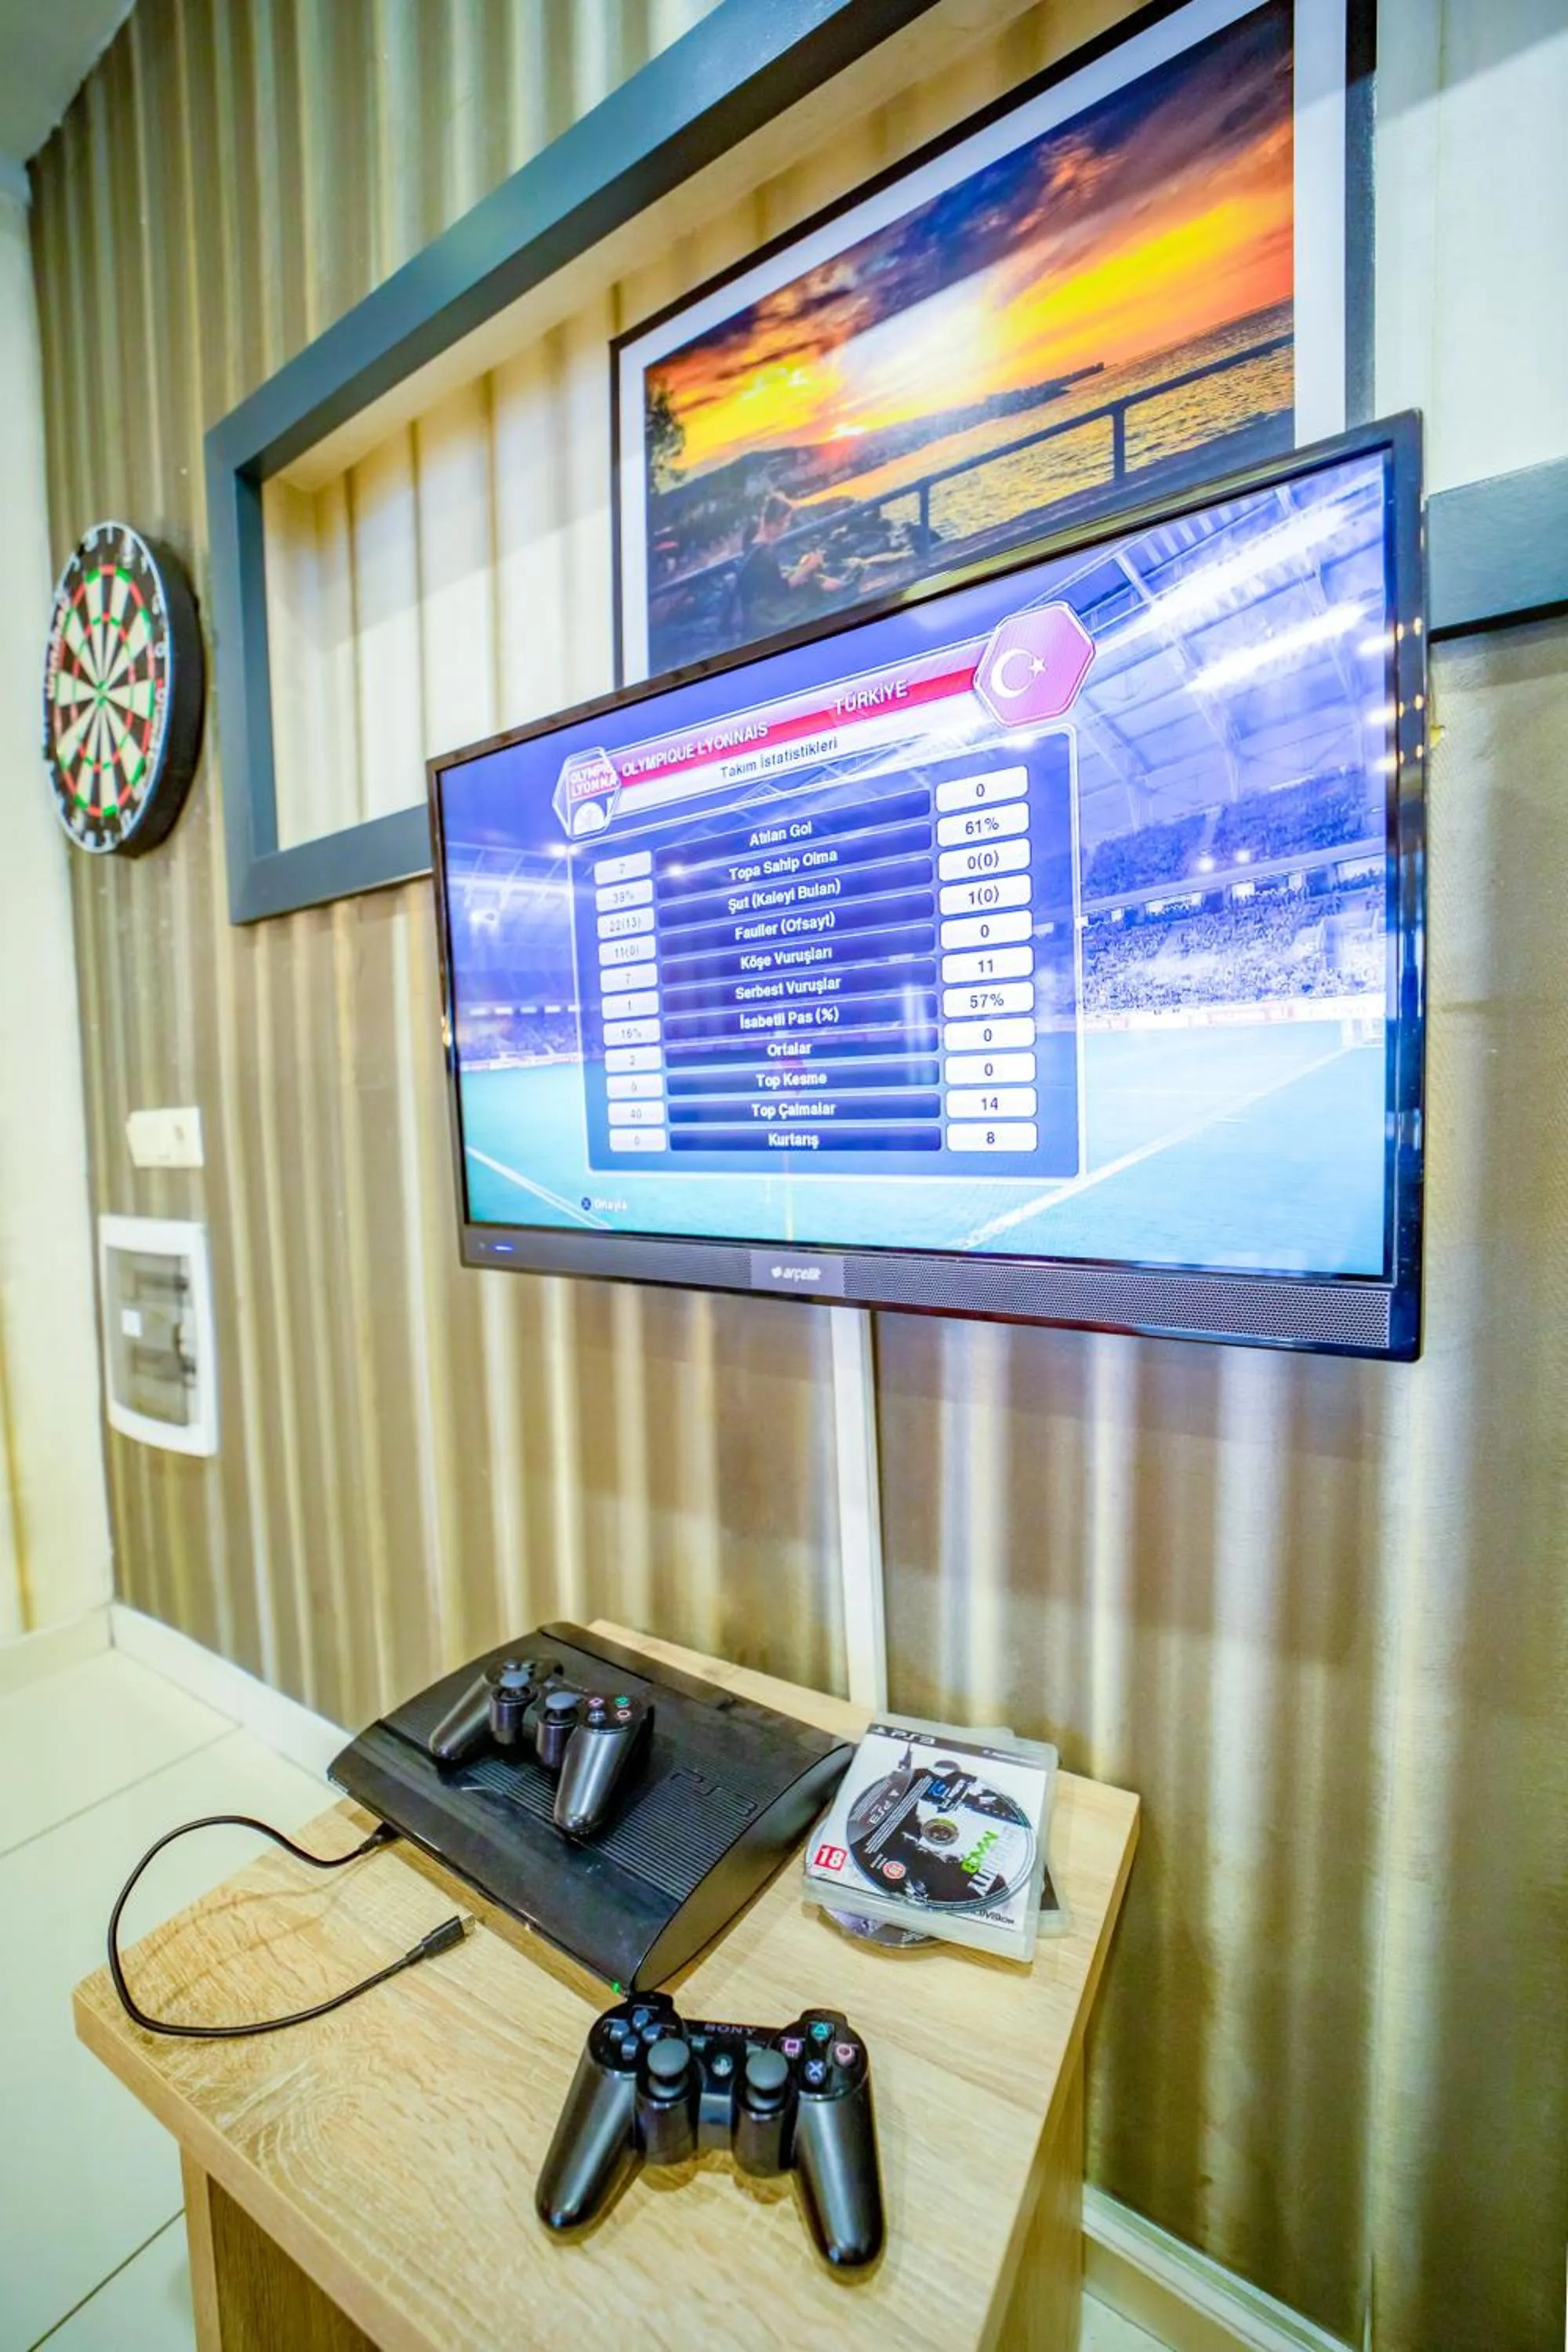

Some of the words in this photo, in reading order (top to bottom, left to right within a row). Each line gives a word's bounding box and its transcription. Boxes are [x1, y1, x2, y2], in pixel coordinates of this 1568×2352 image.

[834, 679, 909, 716] TÜRKİYE
[622, 743, 696, 777] OLYMPIQUE
[697, 721, 769, 756] LYONNAIS
[976, 783, 985, 797] 0
[789, 820, 812, 837] Gol
[965, 816, 1000, 835] 61%
[728, 866, 761, 881] Topa
[763, 857, 800, 874] Sahip
[802, 850, 838, 866] Olma
[967, 850, 1000, 871] 0(0)
[728, 898, 750, 915] Şut
[797, 877, 841, 899] Bulan)
[968, 885, 1000, 906] 1(0)
[735, 923, 779, 940] Fauller
[780, 910, 836, 935] (Ofsayt)
[980, 924, 990, 938] 0
[740, 955, 772, 971] Köşe
[978, 959, 993, 973] 11
[735, 982, 784, 1000] Serbest
[786, 977, 841, 995] Vuruşlar
[970, 993, 1004, 1009] 57%
[788, 1011, 813, 1025] Pas
[815, 1005, 840, 1025] (%)
[983, 1029, 993, 1042] 0
[767, 1041, 812, 1057] Ortalar
[984, 1063, 993, 1076] 0
[755, 1073, 781, 1090] Top
[783, 1072, 828, 1087] Kesme
[751, 1103, 776, 1120] Top
[779, 1102, 837, 1120] Çalmalar
[982, 1097, 998, 1111] 14
[985, 1131, 995, 1145] 8
[818, 1847, 845, 1868] 18
